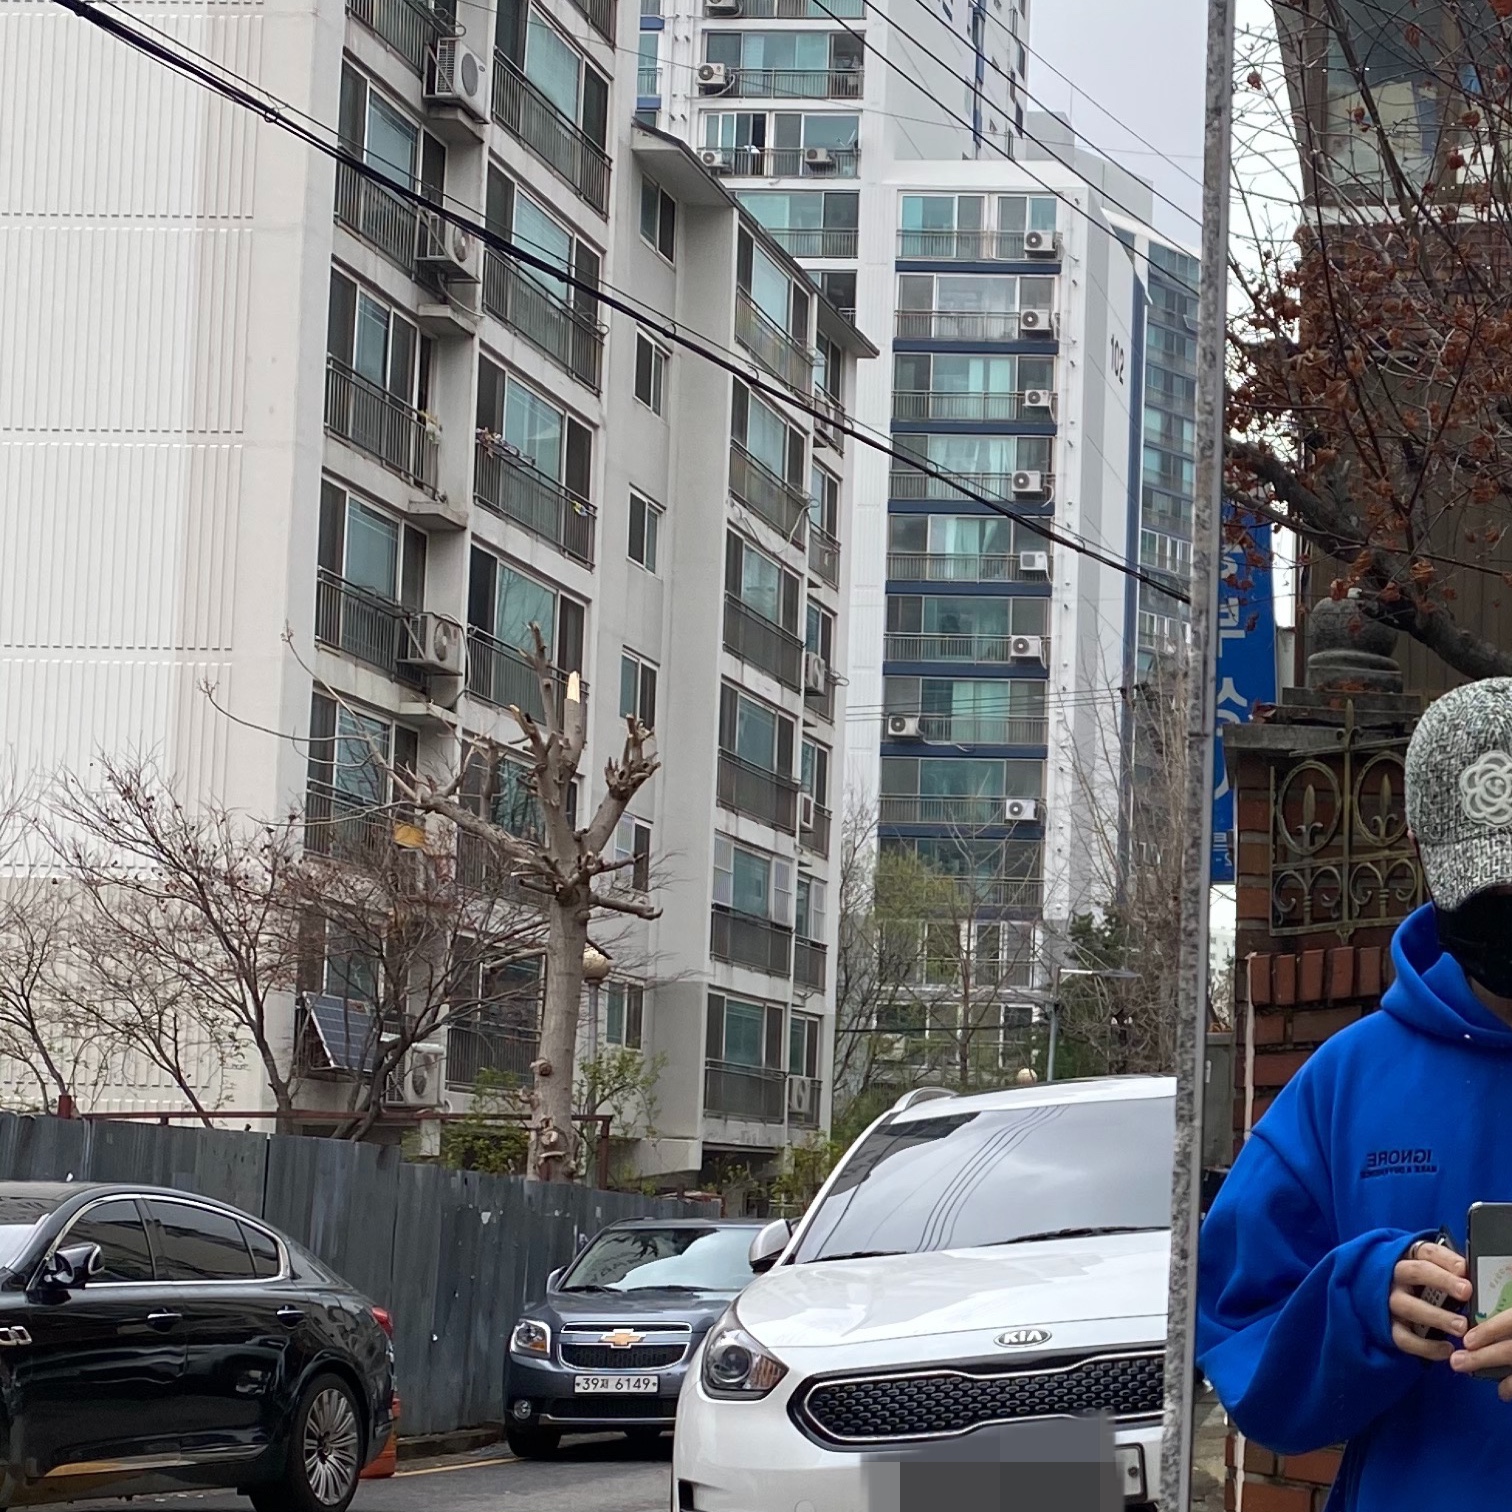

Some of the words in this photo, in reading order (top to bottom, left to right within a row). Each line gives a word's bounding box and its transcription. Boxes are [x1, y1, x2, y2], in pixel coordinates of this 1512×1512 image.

[1110, 334, 1125, 385] 102
[1004, 1330, 1042, 1343] KIA
[615, 1377, 651, 1390] 6149
